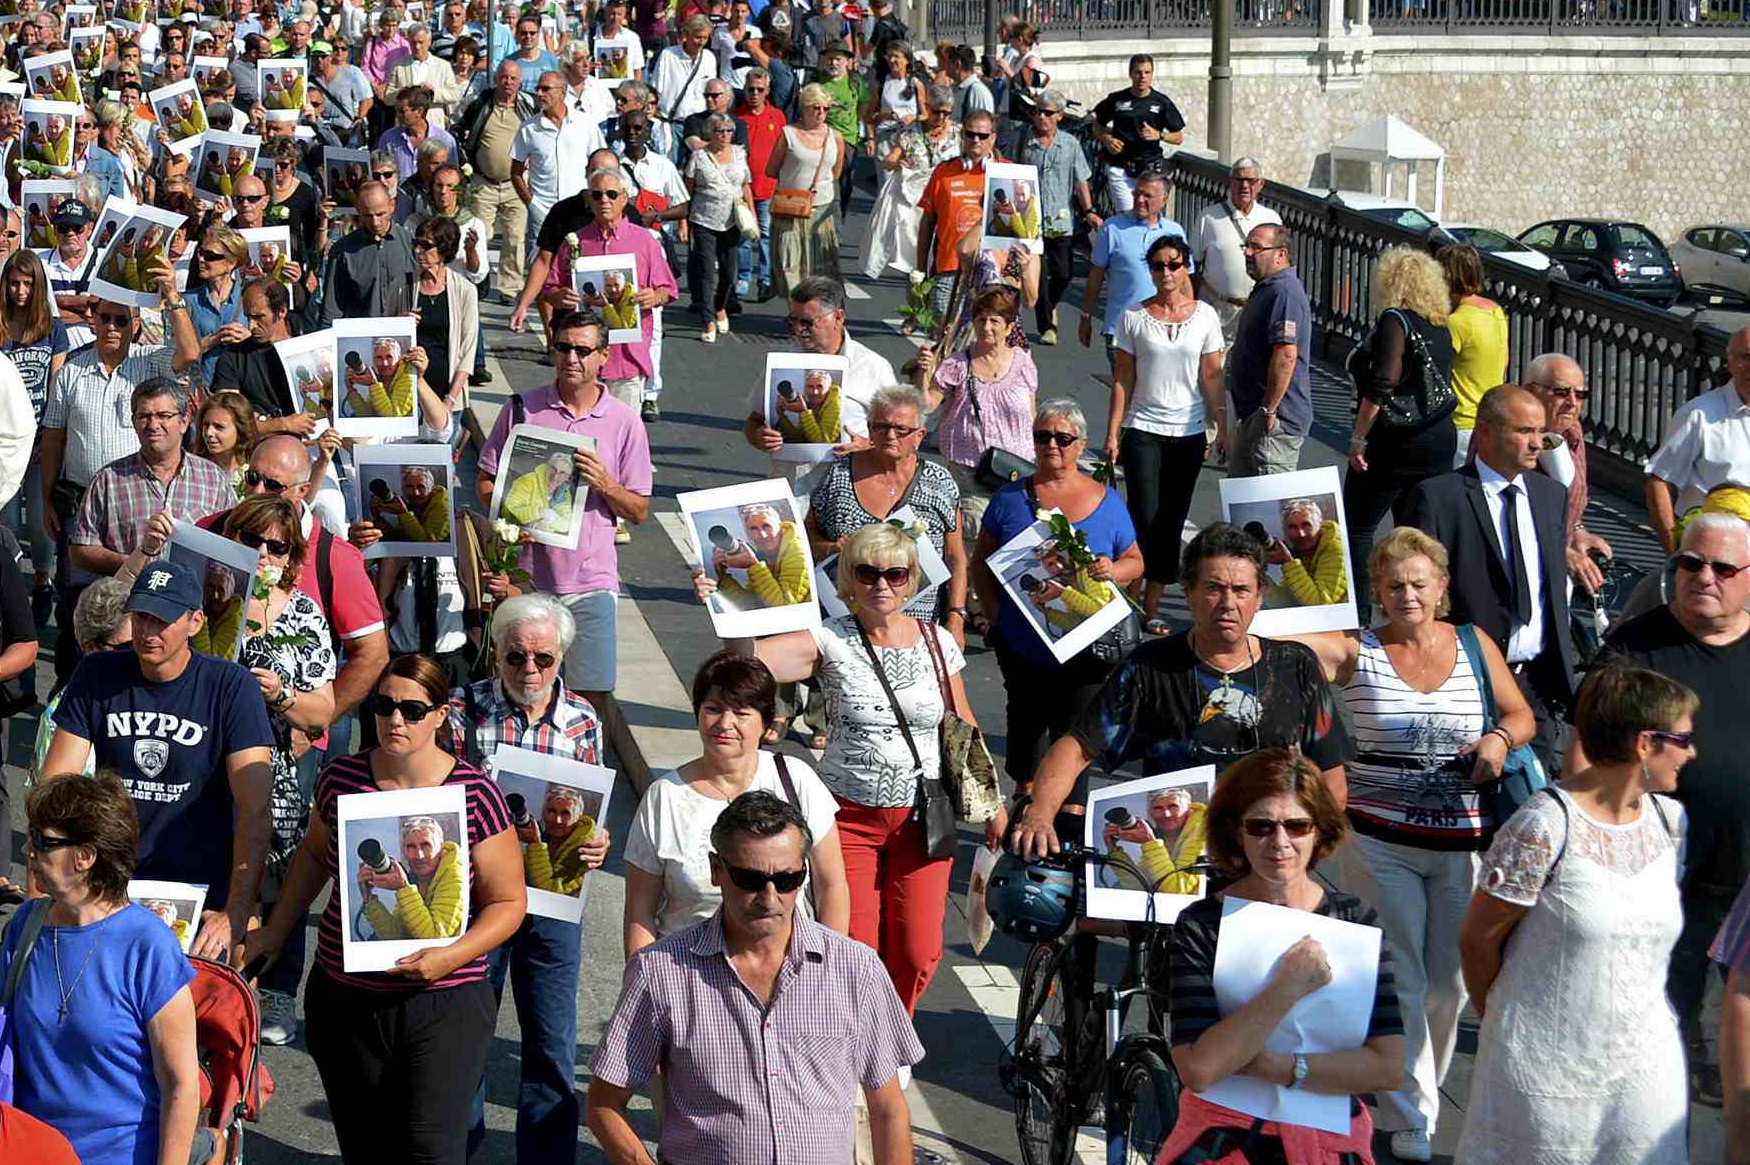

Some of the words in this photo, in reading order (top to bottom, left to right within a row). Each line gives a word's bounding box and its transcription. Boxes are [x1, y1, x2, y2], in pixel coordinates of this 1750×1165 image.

[106, 711, 204, 746] NYPD
[137, 780, 165, 792] YORK
[167, 781, 191, 794] CITY
[154, 792, 181, 803] DEPT
[1404, 807, 1459, 828] PARIS
